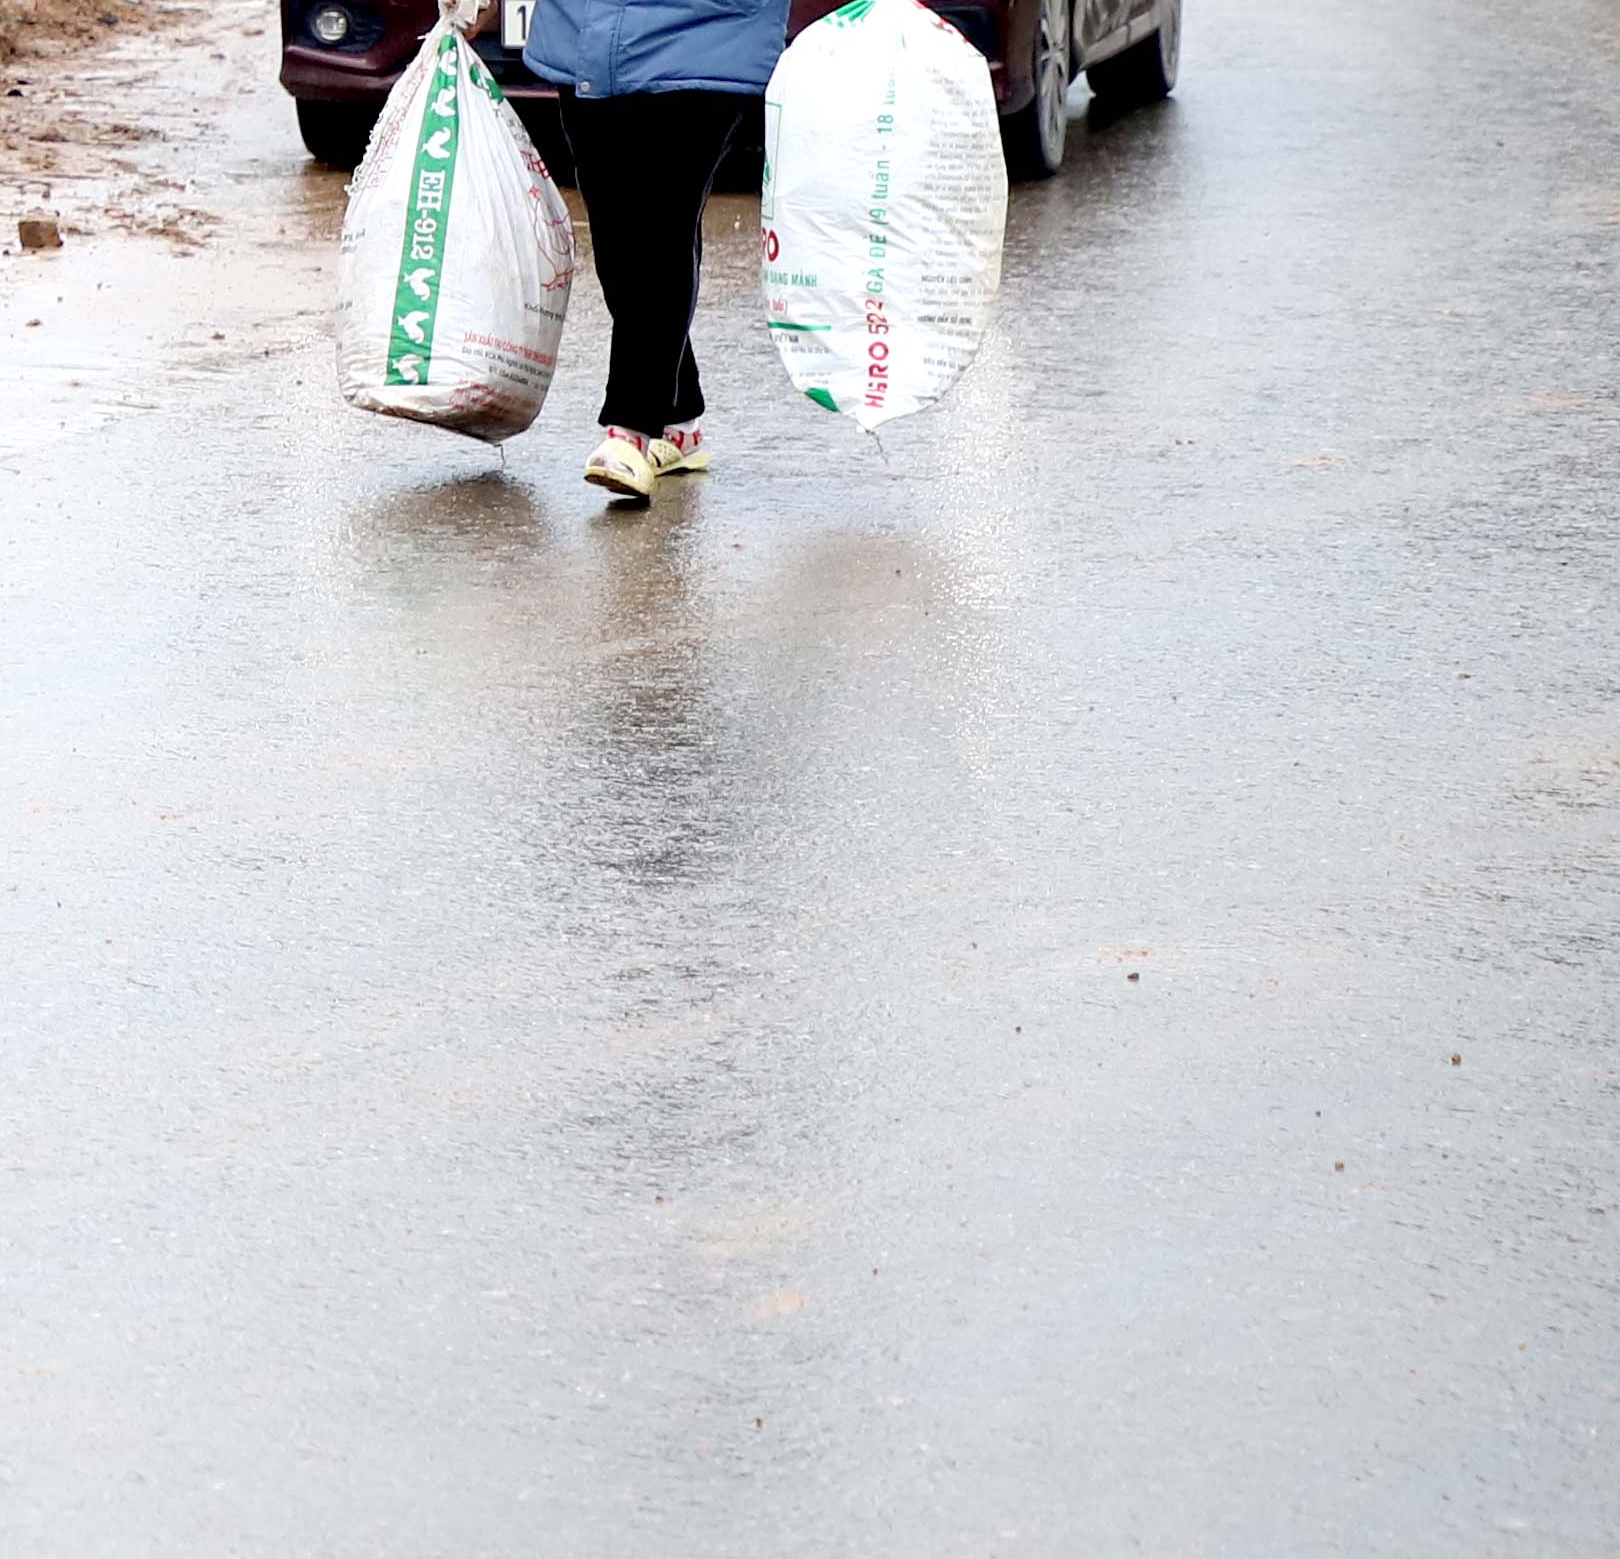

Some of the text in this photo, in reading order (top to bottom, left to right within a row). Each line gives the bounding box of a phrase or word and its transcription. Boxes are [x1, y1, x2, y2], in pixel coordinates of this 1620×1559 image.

[875, 114, 894, 134] 18
[410, 169, 446, 260] EH-912
[864, 299, 890, 335] 522
